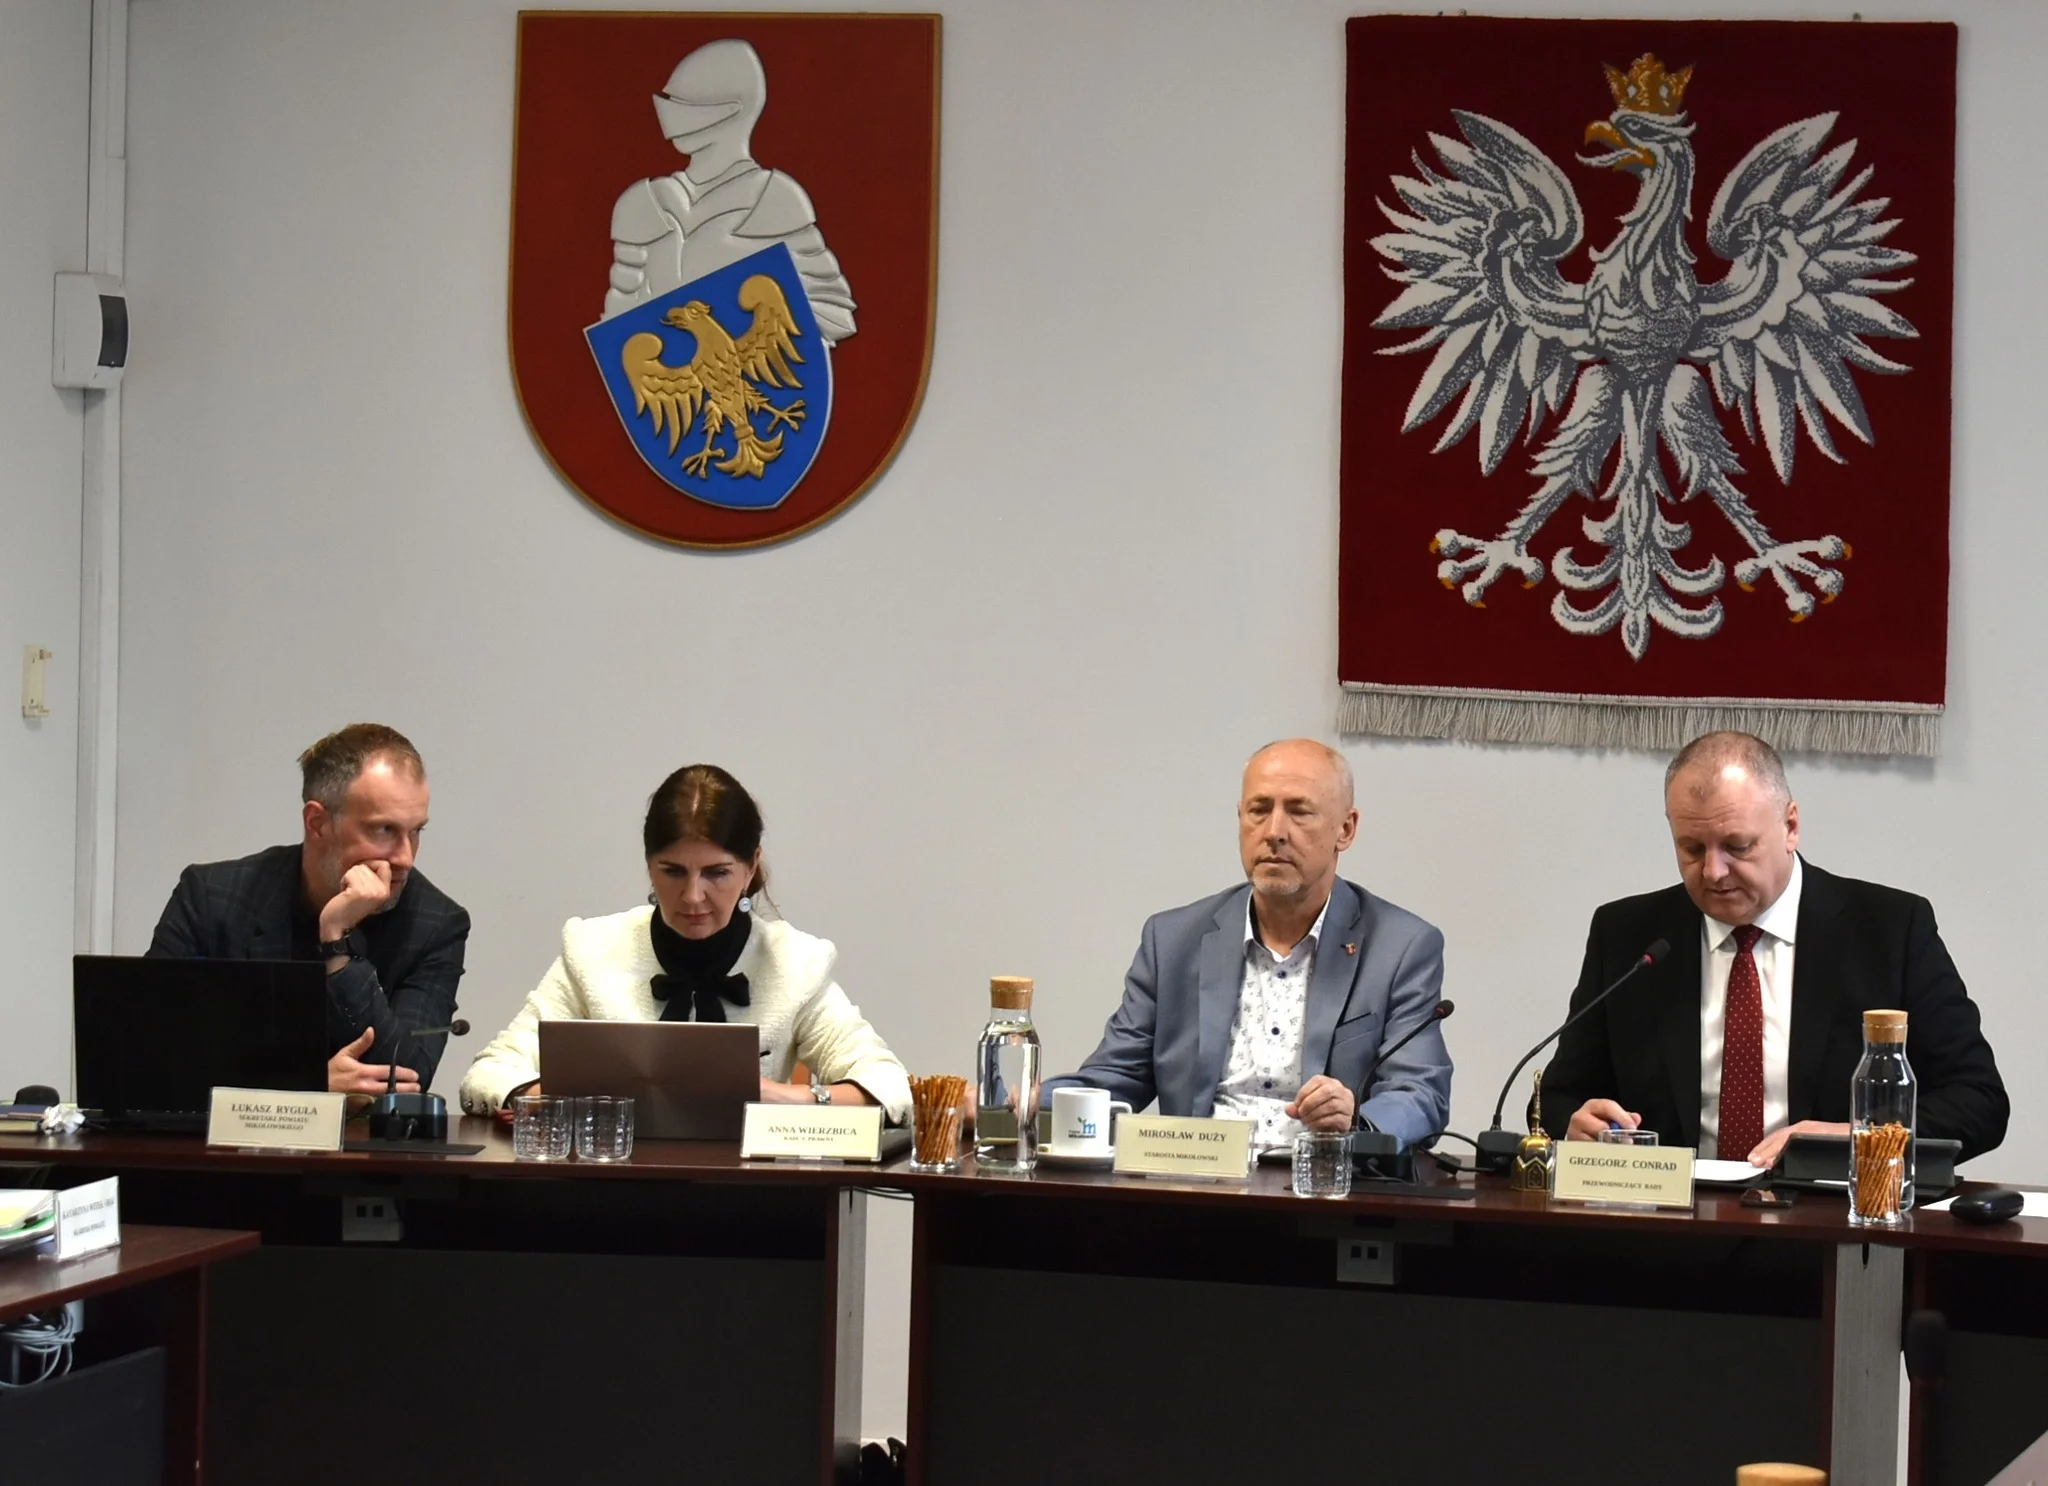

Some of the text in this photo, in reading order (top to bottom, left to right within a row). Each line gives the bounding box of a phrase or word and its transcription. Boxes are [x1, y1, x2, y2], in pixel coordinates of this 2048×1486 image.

[231, 1103, 272, 1113] ŁUKASZ
[767, 1125, 796, 1134] ANNA
[1138, 1128, 1227, 1142] MIROSŁAW DUŻY
[1568, 1155, 1678, 1172] GRZEGORZ CONRAD
